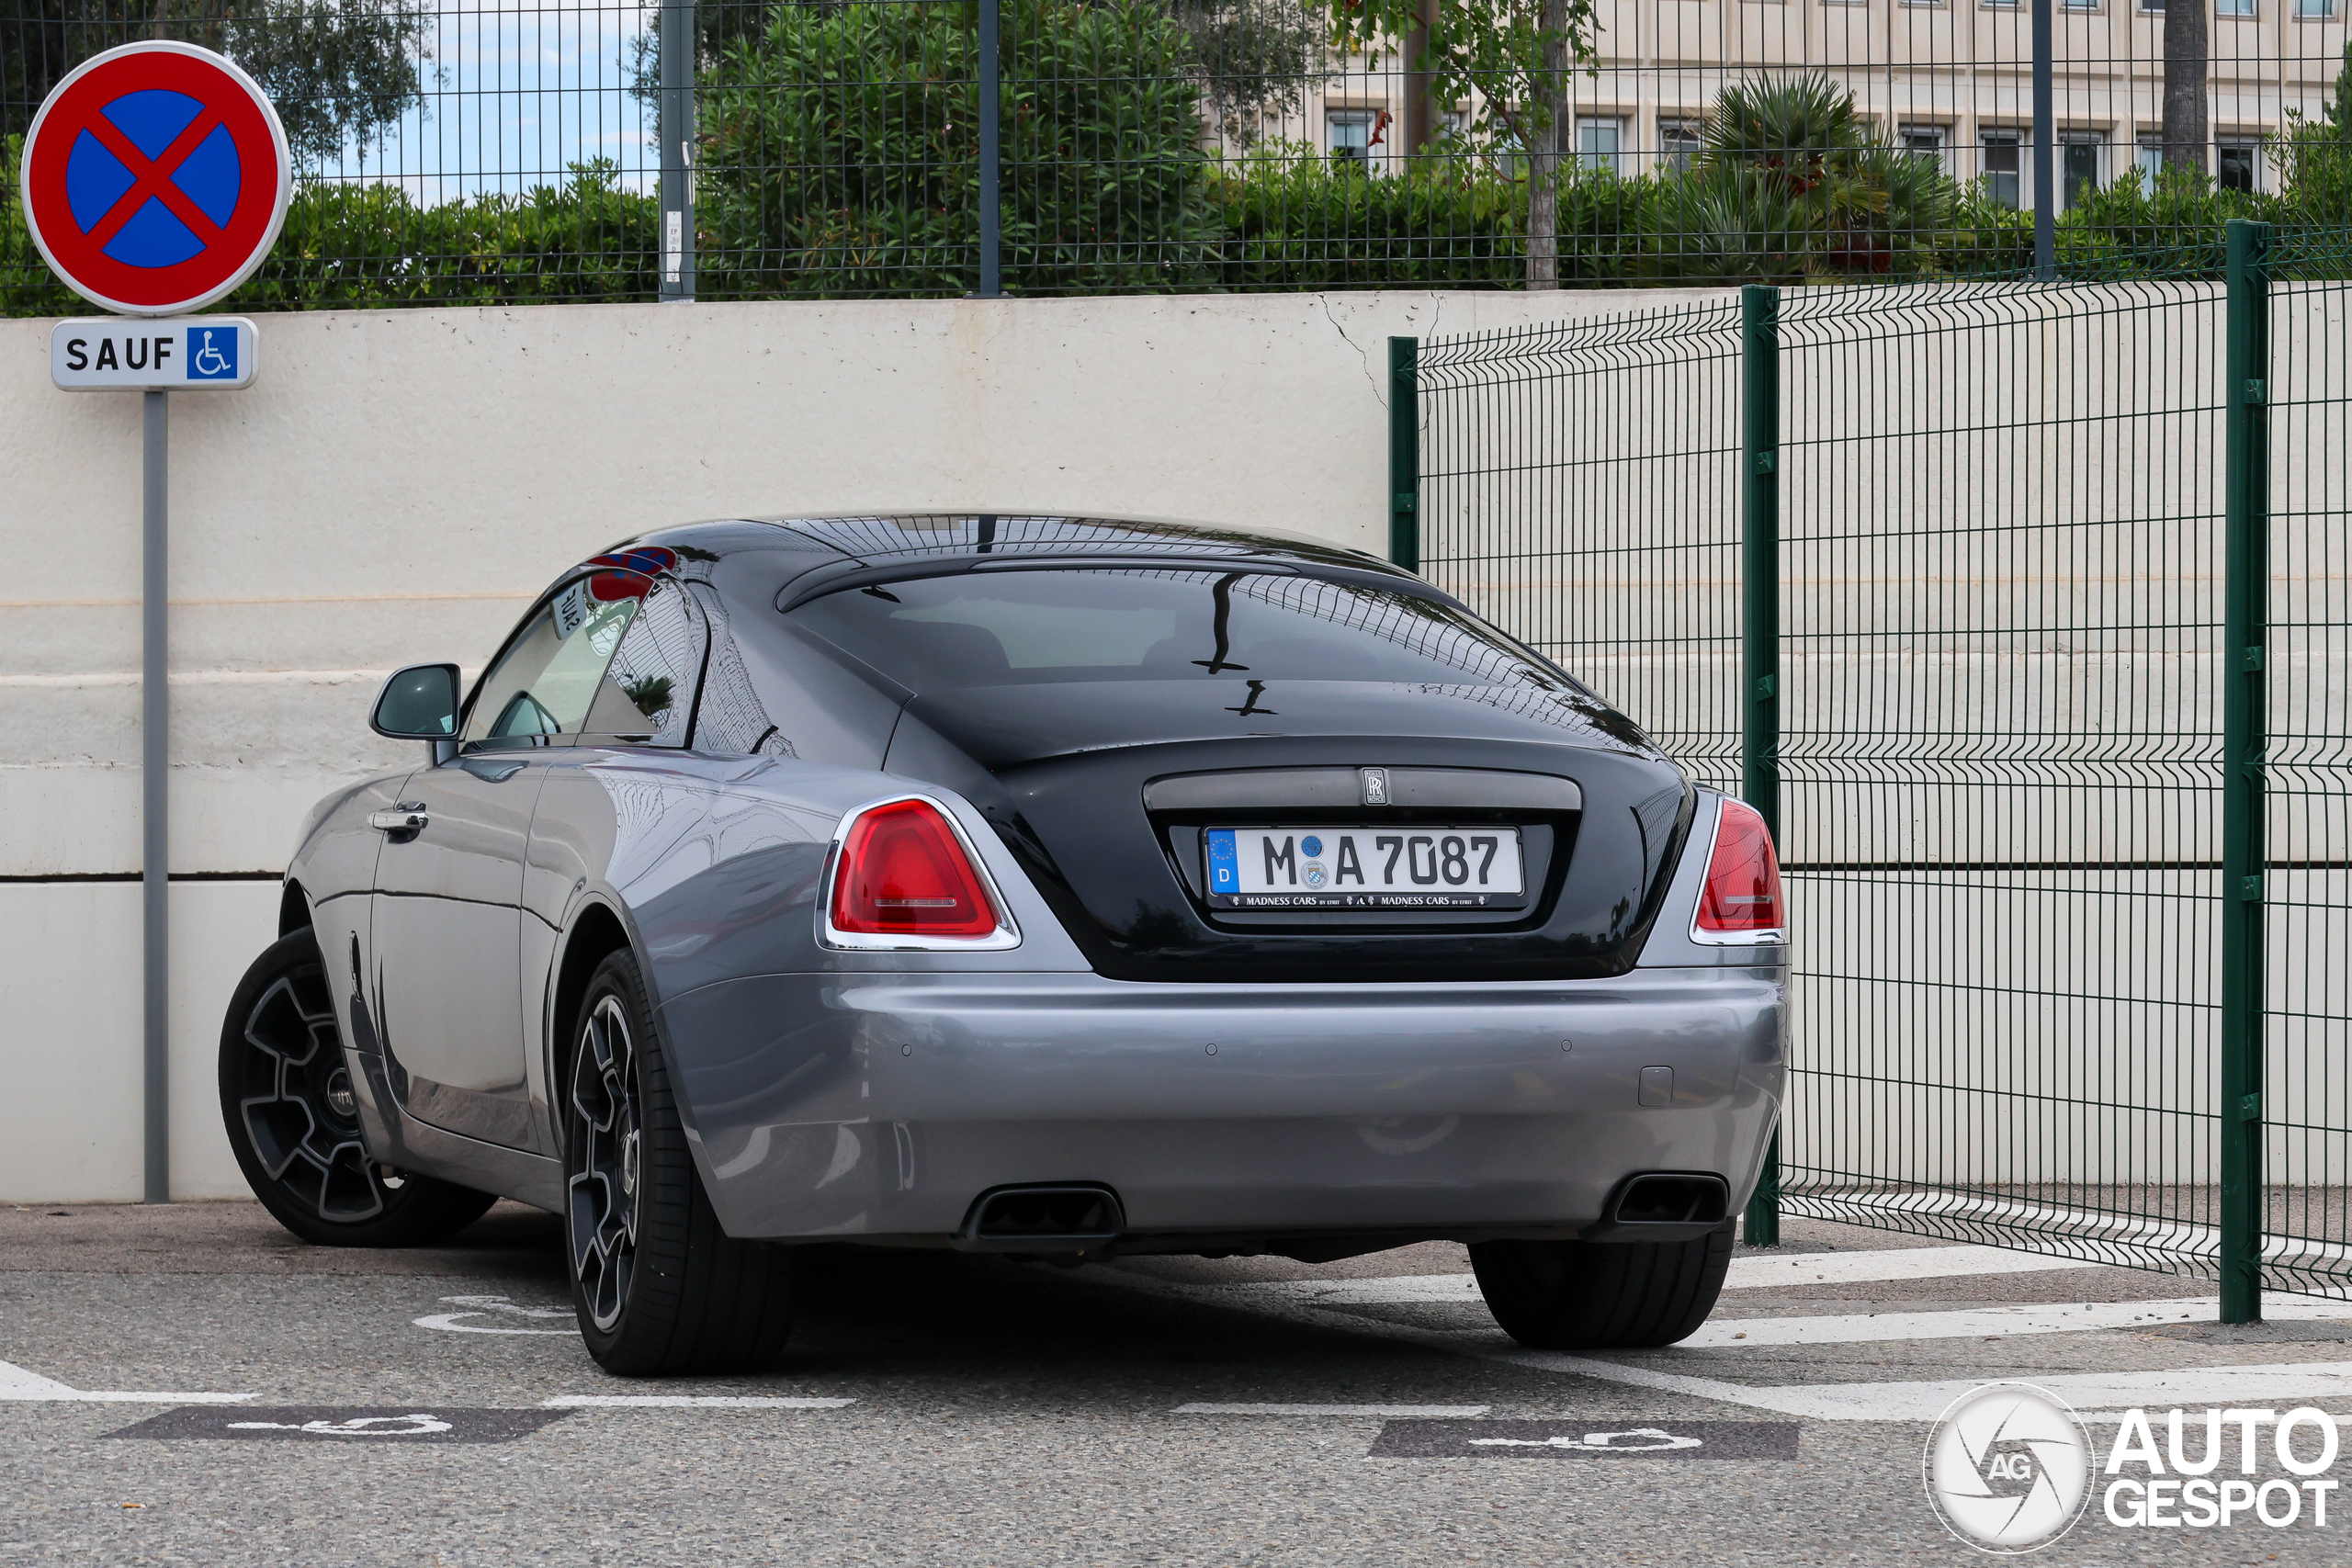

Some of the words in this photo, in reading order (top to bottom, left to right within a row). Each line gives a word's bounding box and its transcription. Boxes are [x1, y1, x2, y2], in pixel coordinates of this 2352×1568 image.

[66, 337, 174, 370] SAUF
[1262, 836, 1297, 886] M
[1218, 868, 1230, 883] D
[1246, 897, 1290, 906] MADNESS
[1293, 897, 1317, 906] CARS
[1381, 897, 1424, 905] MADNESS
[1426, 897, 1450, 905] CARS
